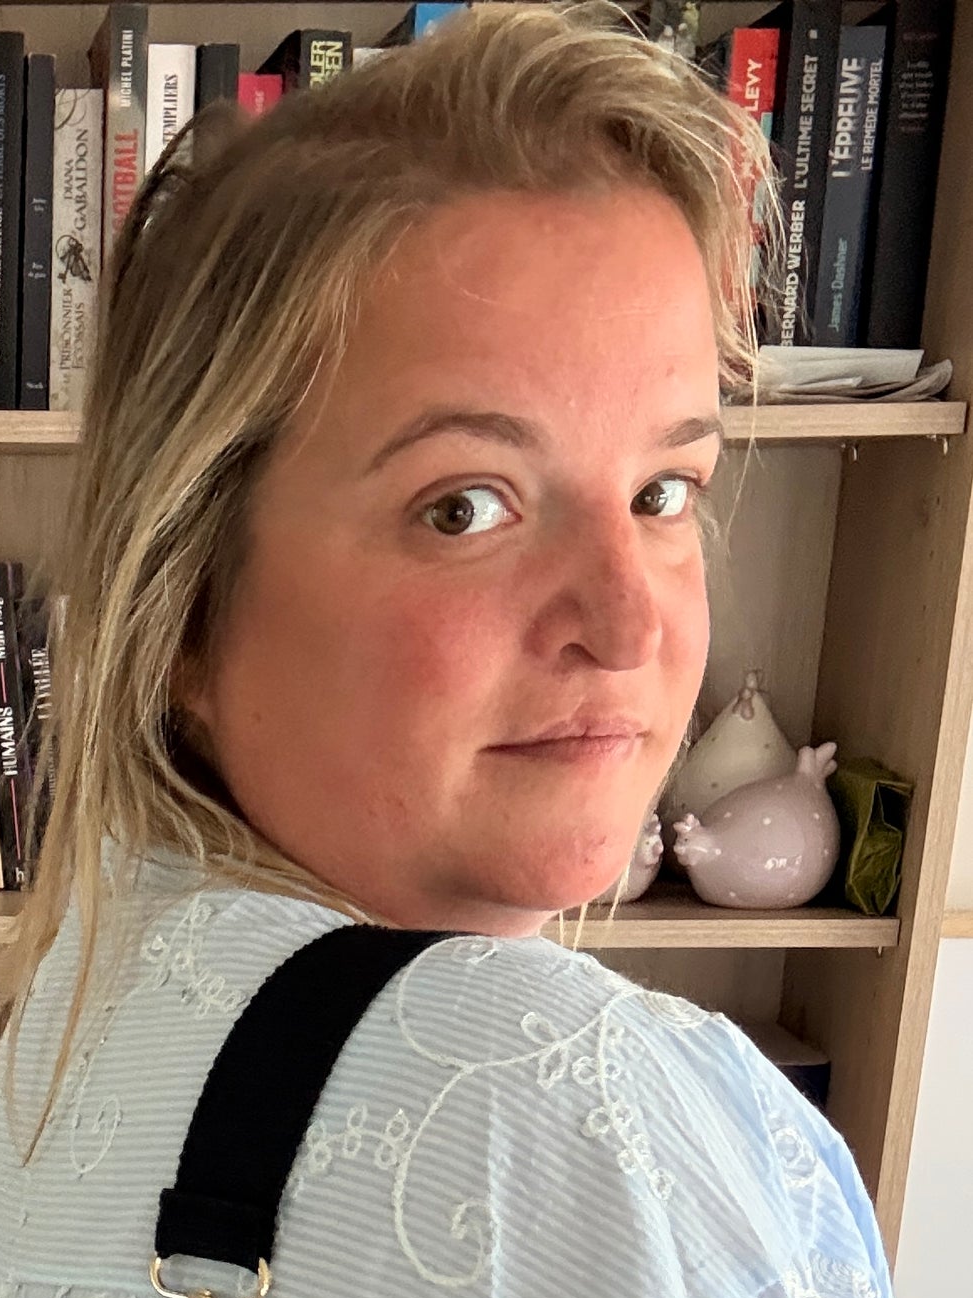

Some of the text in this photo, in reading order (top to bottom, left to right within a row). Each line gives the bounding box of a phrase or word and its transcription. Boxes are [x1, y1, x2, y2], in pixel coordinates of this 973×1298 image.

[121, 30, 134, 69] PLATINI
[746, 58, 762, 112] LEVY
[830, 57, 862, 177] L'ÉPREUVE
[861, 59, 884, 170] LE REMÈDE MORTEL
[793, 54, 818, 189] L'ULTIME SECRET
[63, 159, 75, 200] DIANA
[73, 128, 89, 230] GABALDON
[788, 200, 806, 270] WERBER
[828, 292, 844, 332] James
